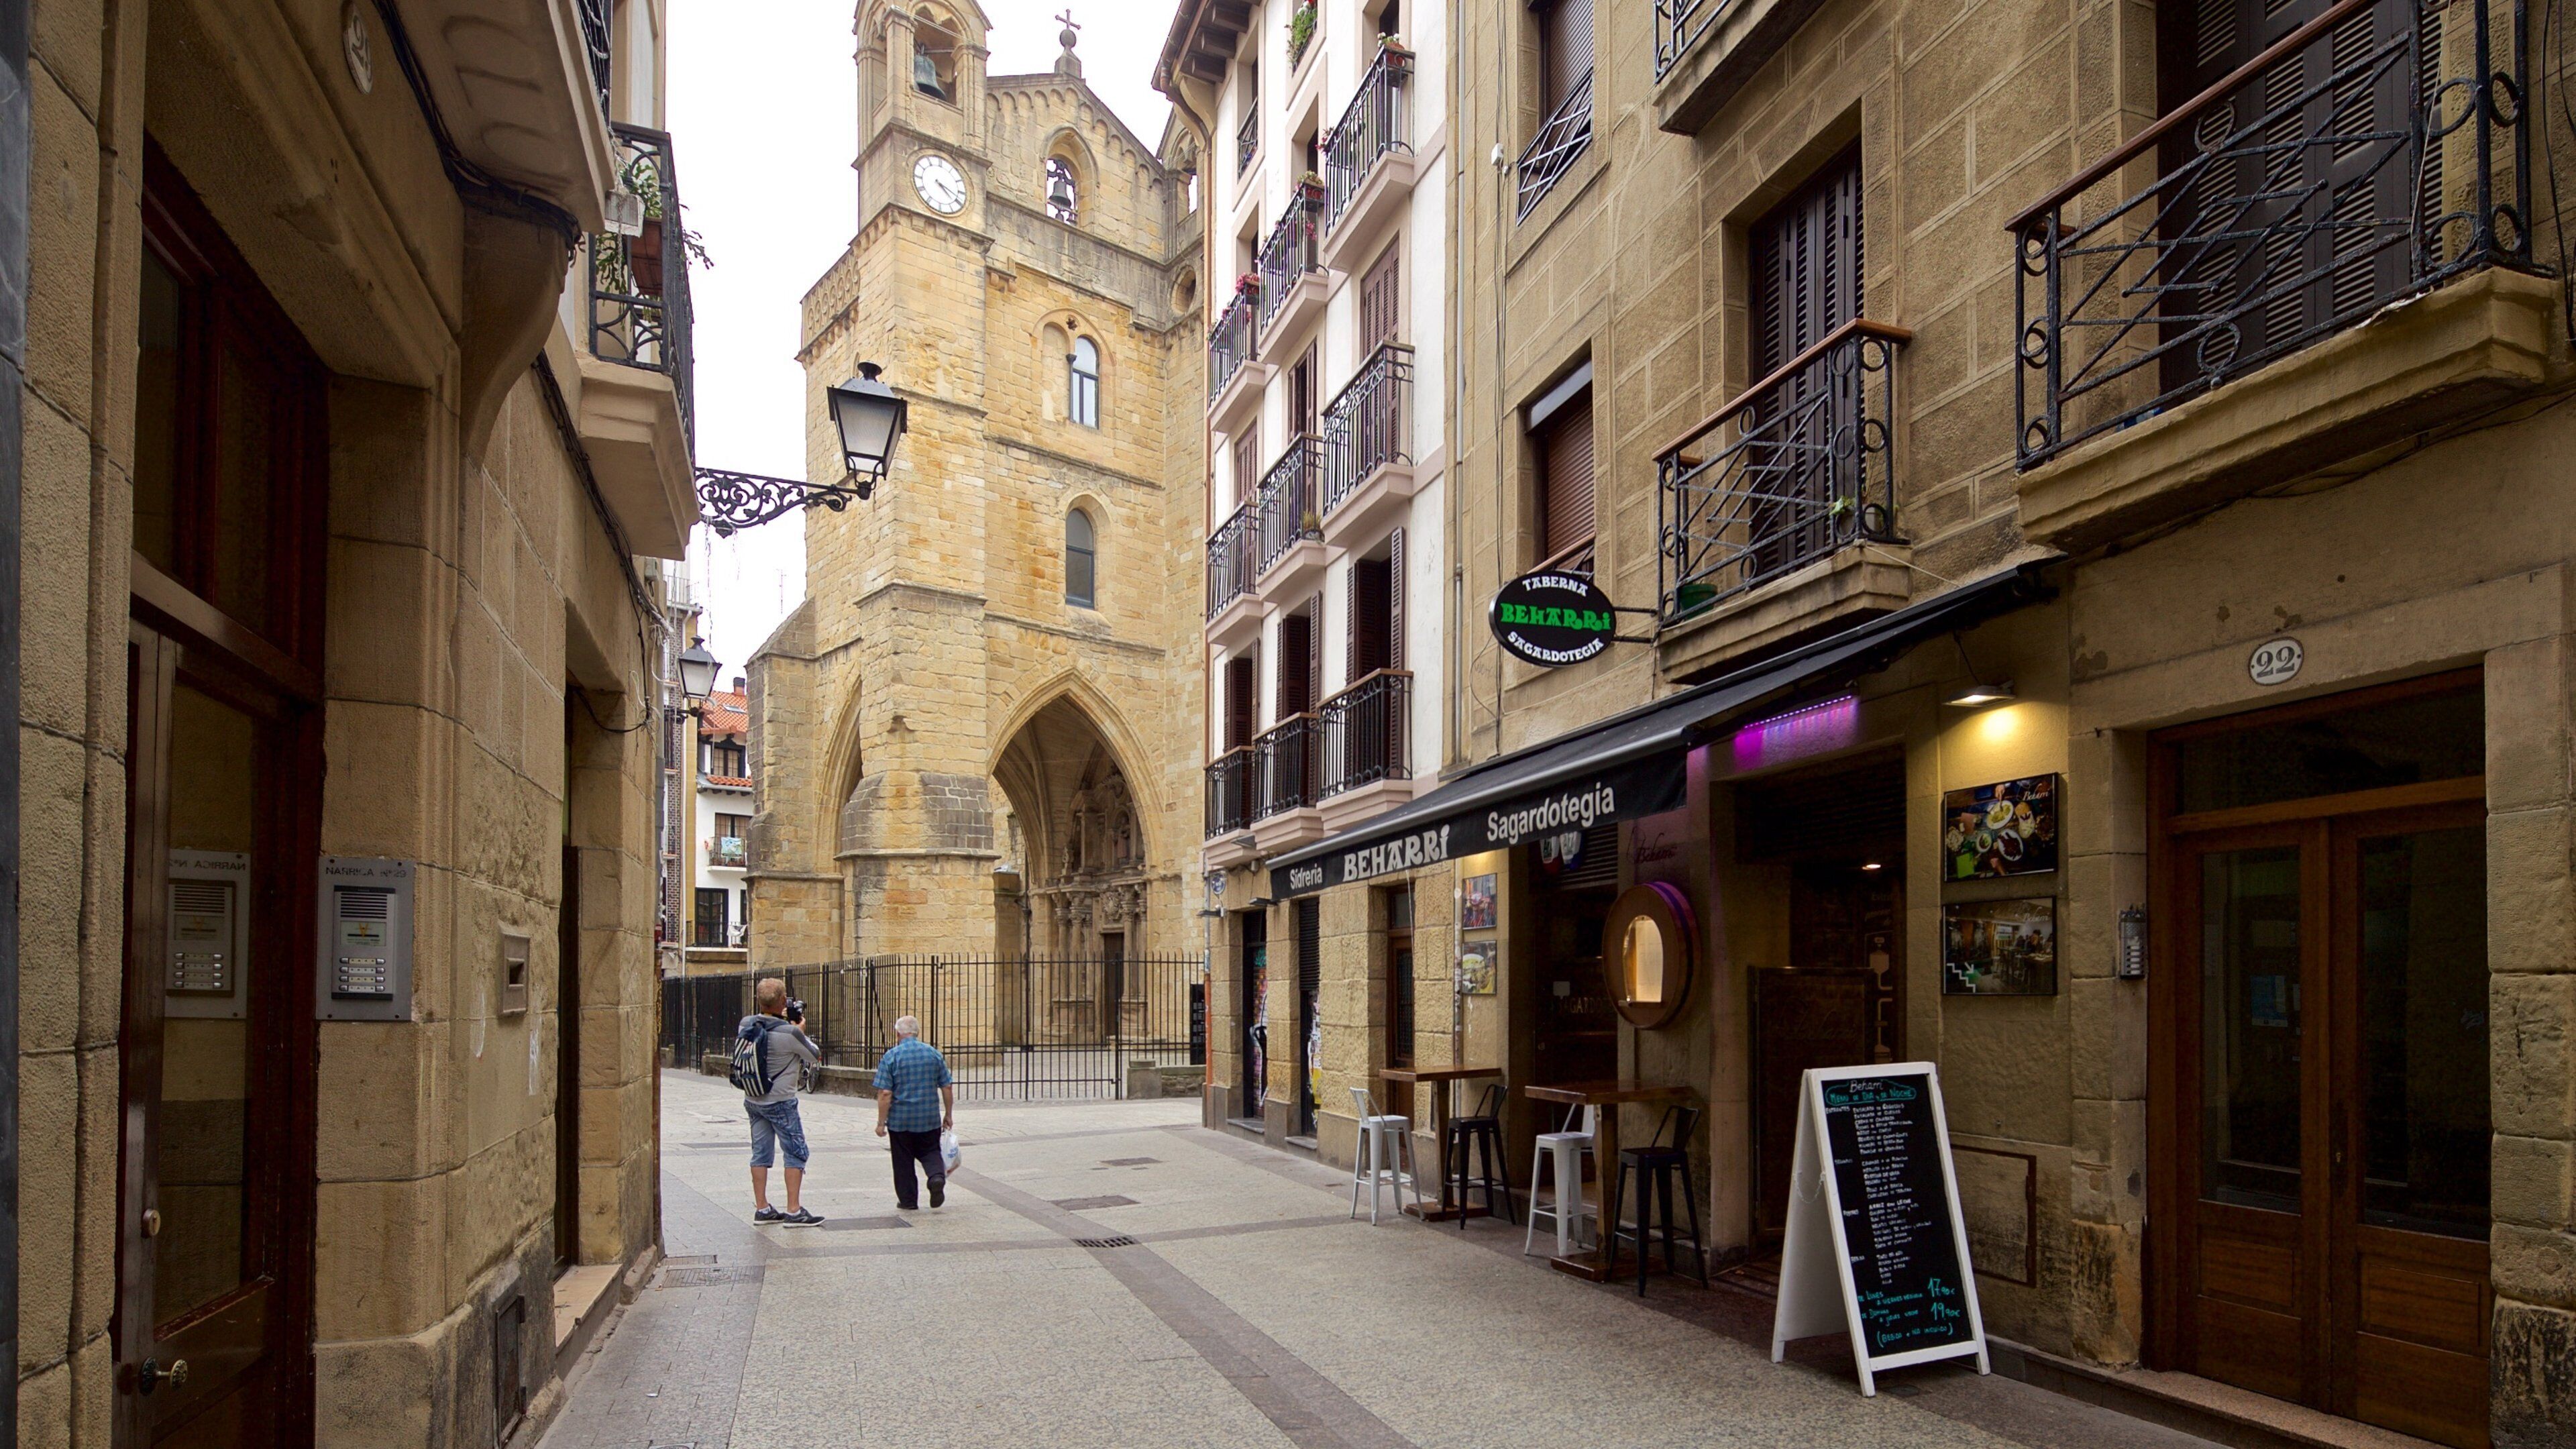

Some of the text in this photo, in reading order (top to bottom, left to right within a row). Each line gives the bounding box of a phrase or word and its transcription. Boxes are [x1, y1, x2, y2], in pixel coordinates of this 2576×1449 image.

[1522, 576, 1588, 597] TABERNA
[2256, 646, 2295, 678] 22
[1487, 782, 1615, 845] Sagardotegia
[325, 867, 374, 876] NARRICA
